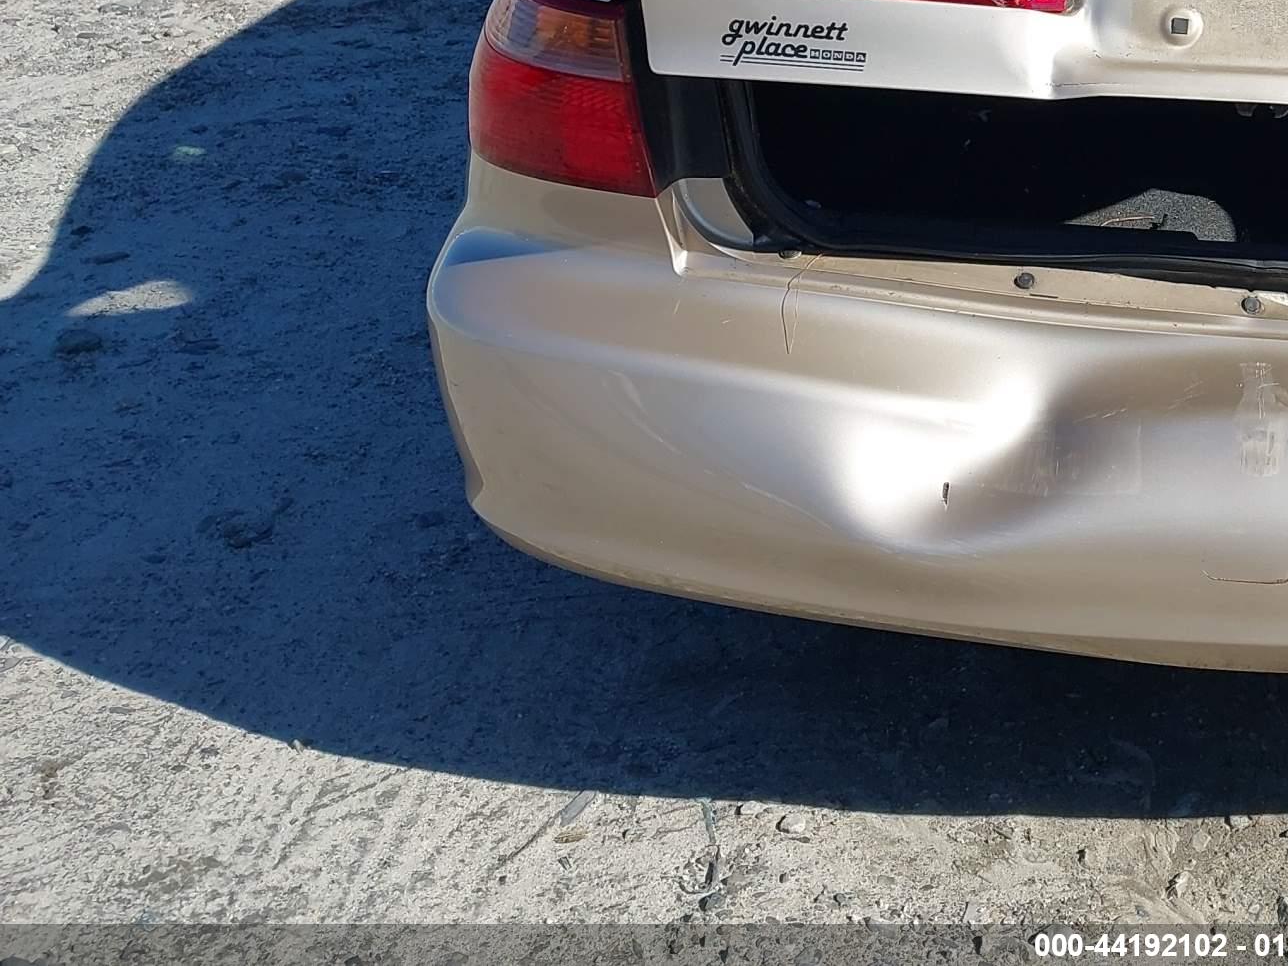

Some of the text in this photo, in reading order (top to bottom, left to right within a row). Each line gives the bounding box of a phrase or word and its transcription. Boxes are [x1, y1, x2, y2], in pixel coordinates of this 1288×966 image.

[721, 16, 848, 46] gwinnett
[732, 36, 867, 67] place HONDA
